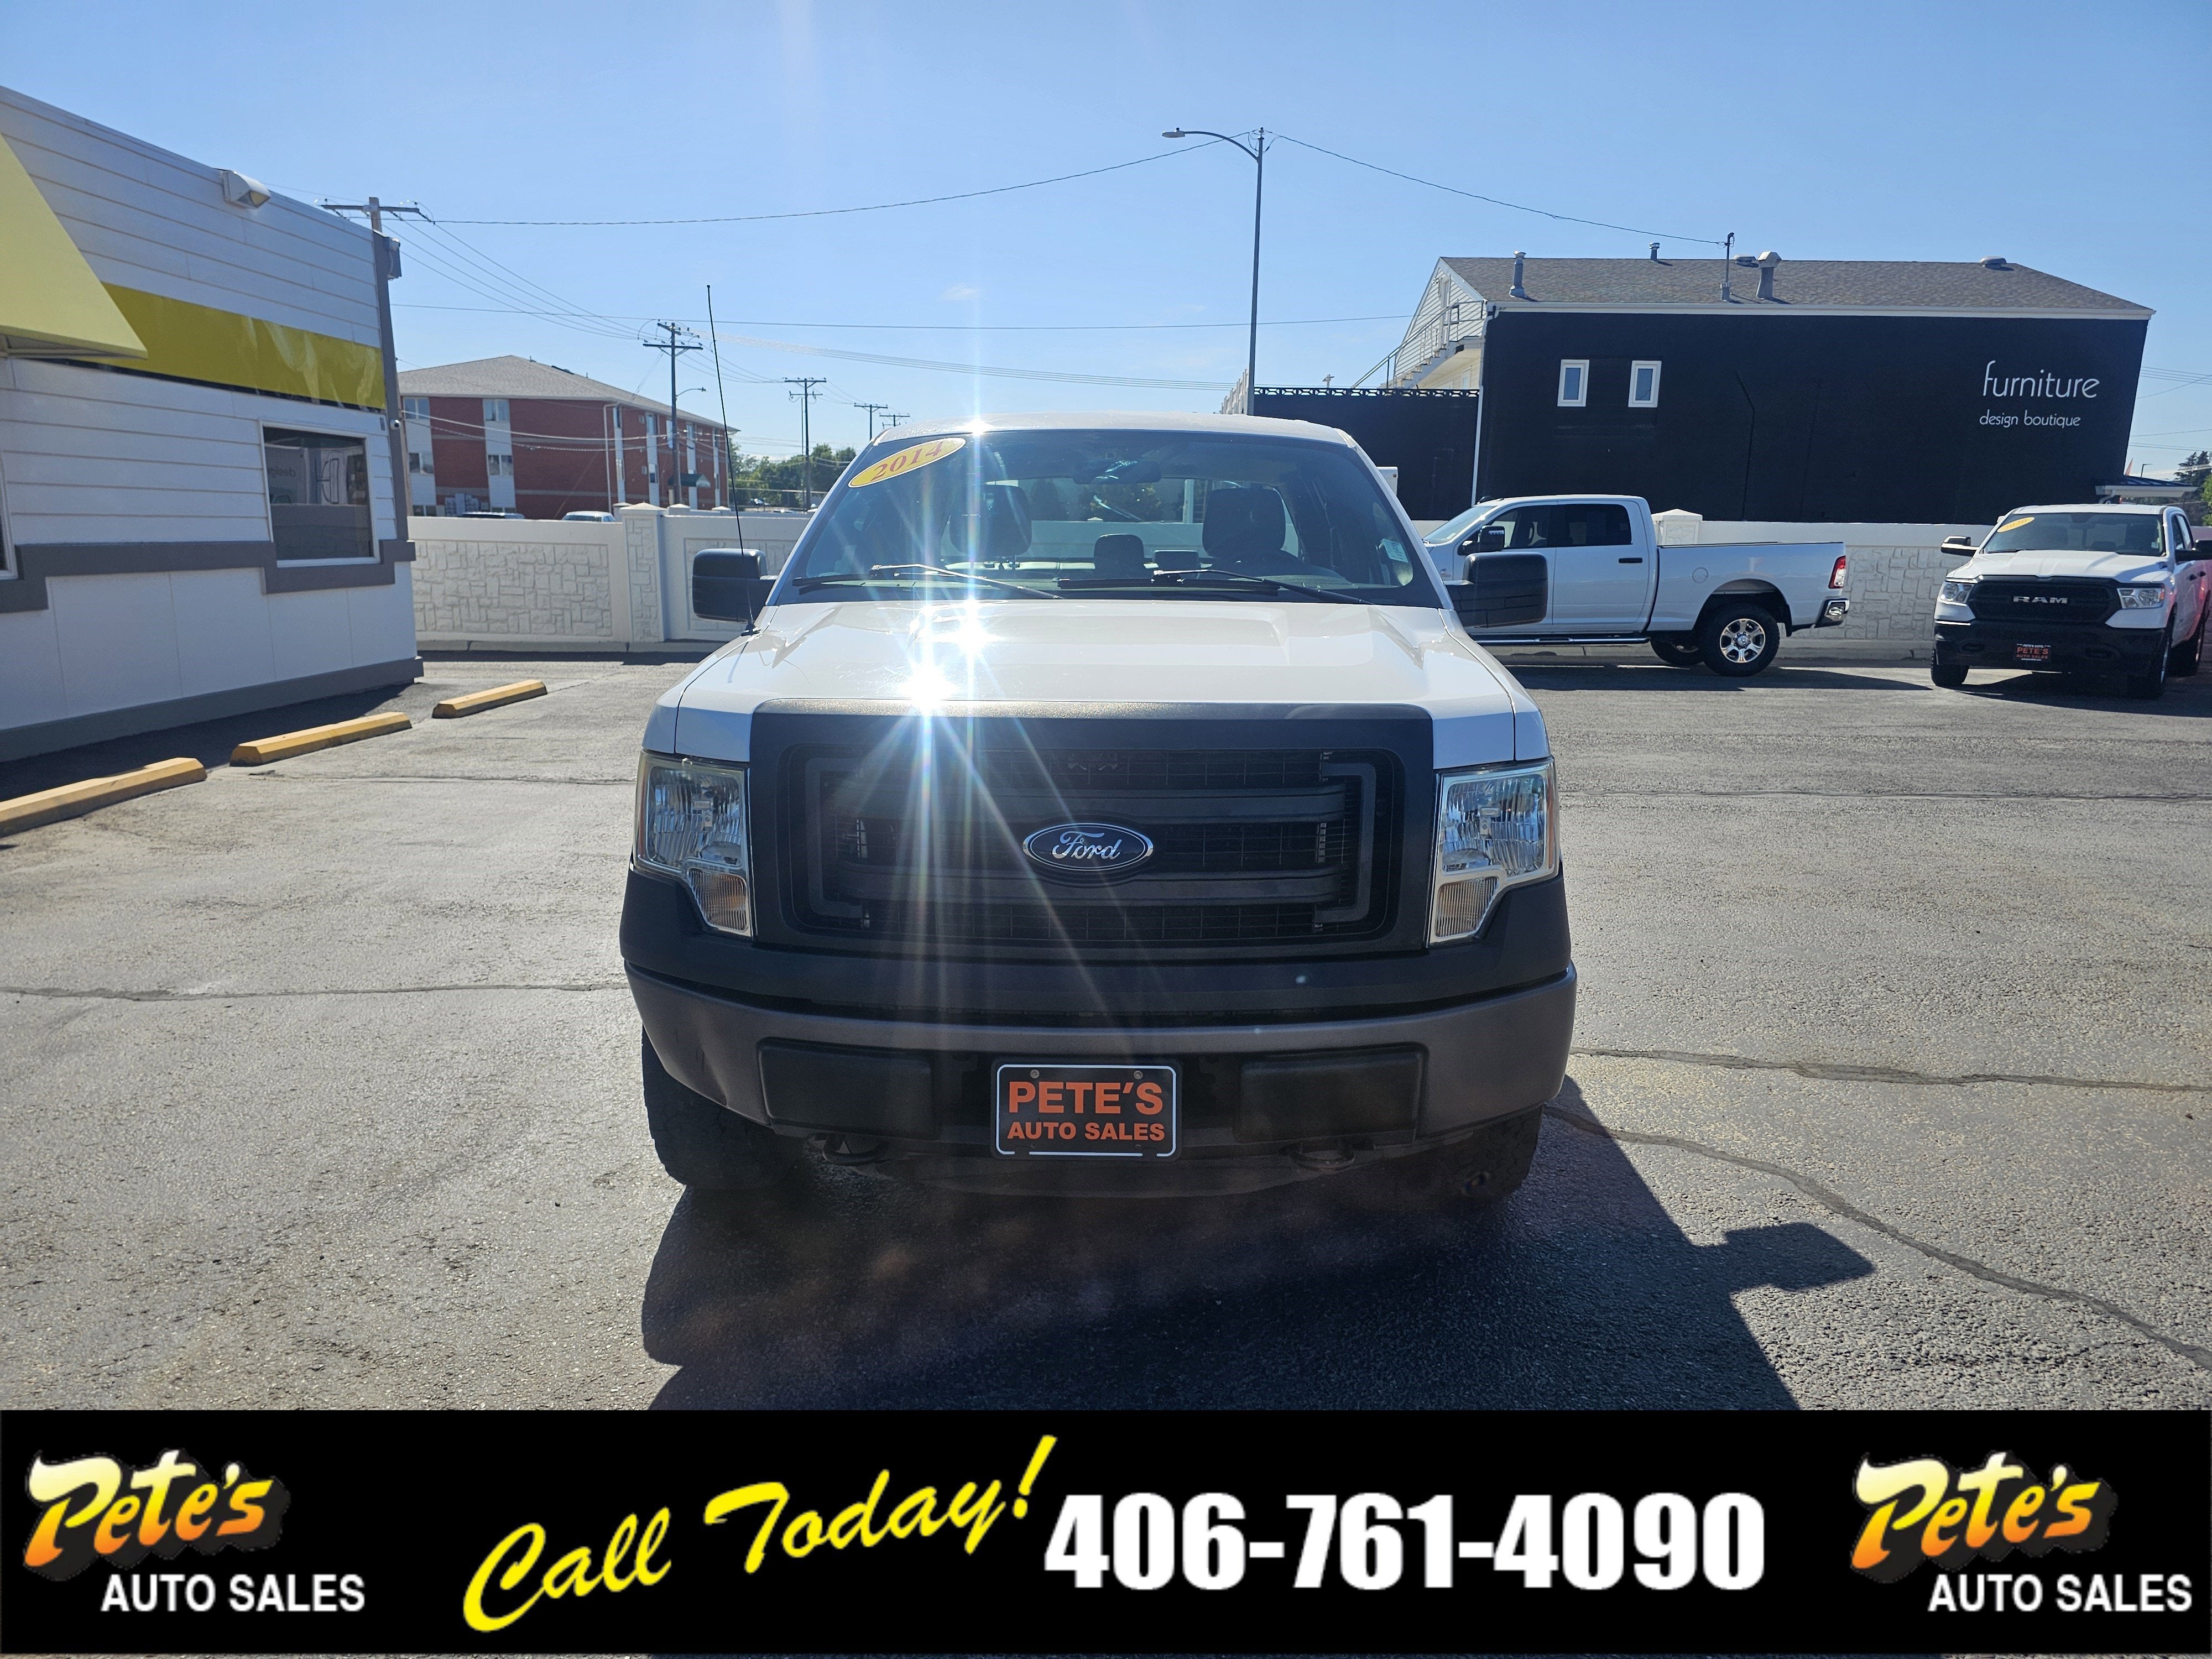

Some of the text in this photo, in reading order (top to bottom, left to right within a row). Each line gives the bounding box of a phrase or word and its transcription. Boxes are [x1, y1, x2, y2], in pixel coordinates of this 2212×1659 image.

[1983, 360, 2100, 398] furniture
[1979, 409, 2081, 429] design boutique
[870, 441, 945, 482] 2014
[2013, 596, 2068, 604] RAM
[2017, 646, 2049, 655] PETE'S
[1051, 831, 1123, 860] Ford
[1009, 1081, 1164, 1115] PETE'S
[1007, 1121, 1165, 1141] AUTO SALES
